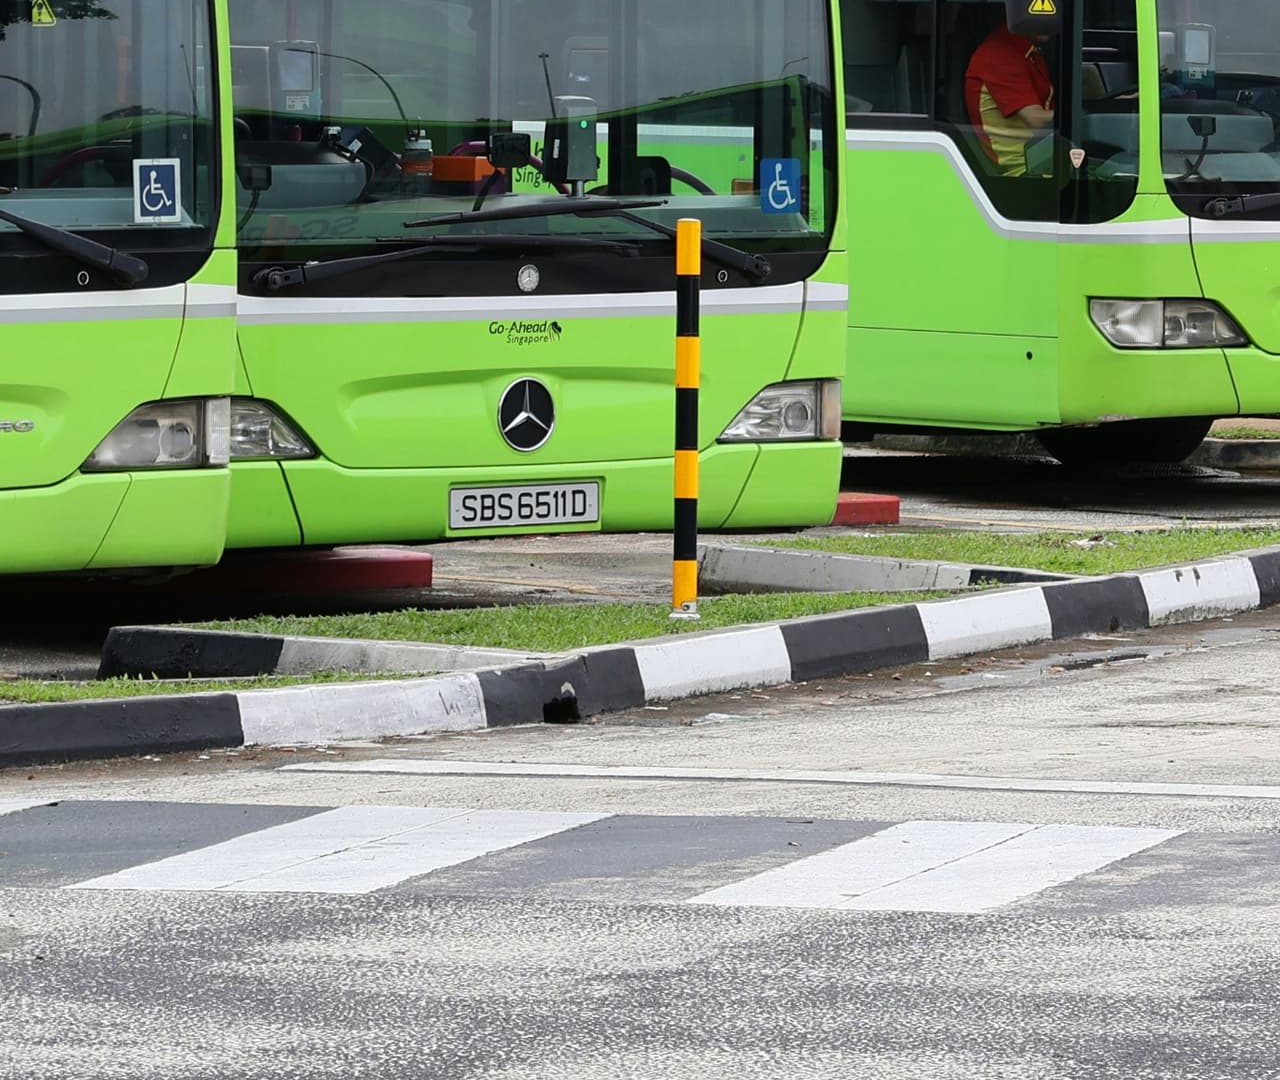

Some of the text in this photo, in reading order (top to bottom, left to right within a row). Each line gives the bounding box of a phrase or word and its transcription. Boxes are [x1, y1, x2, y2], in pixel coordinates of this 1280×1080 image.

[489, 321, 547, 334] Go-Ahead
[506, 334, 549, 346] Singapore
[462, 490, 586, 521] SBS6511D
